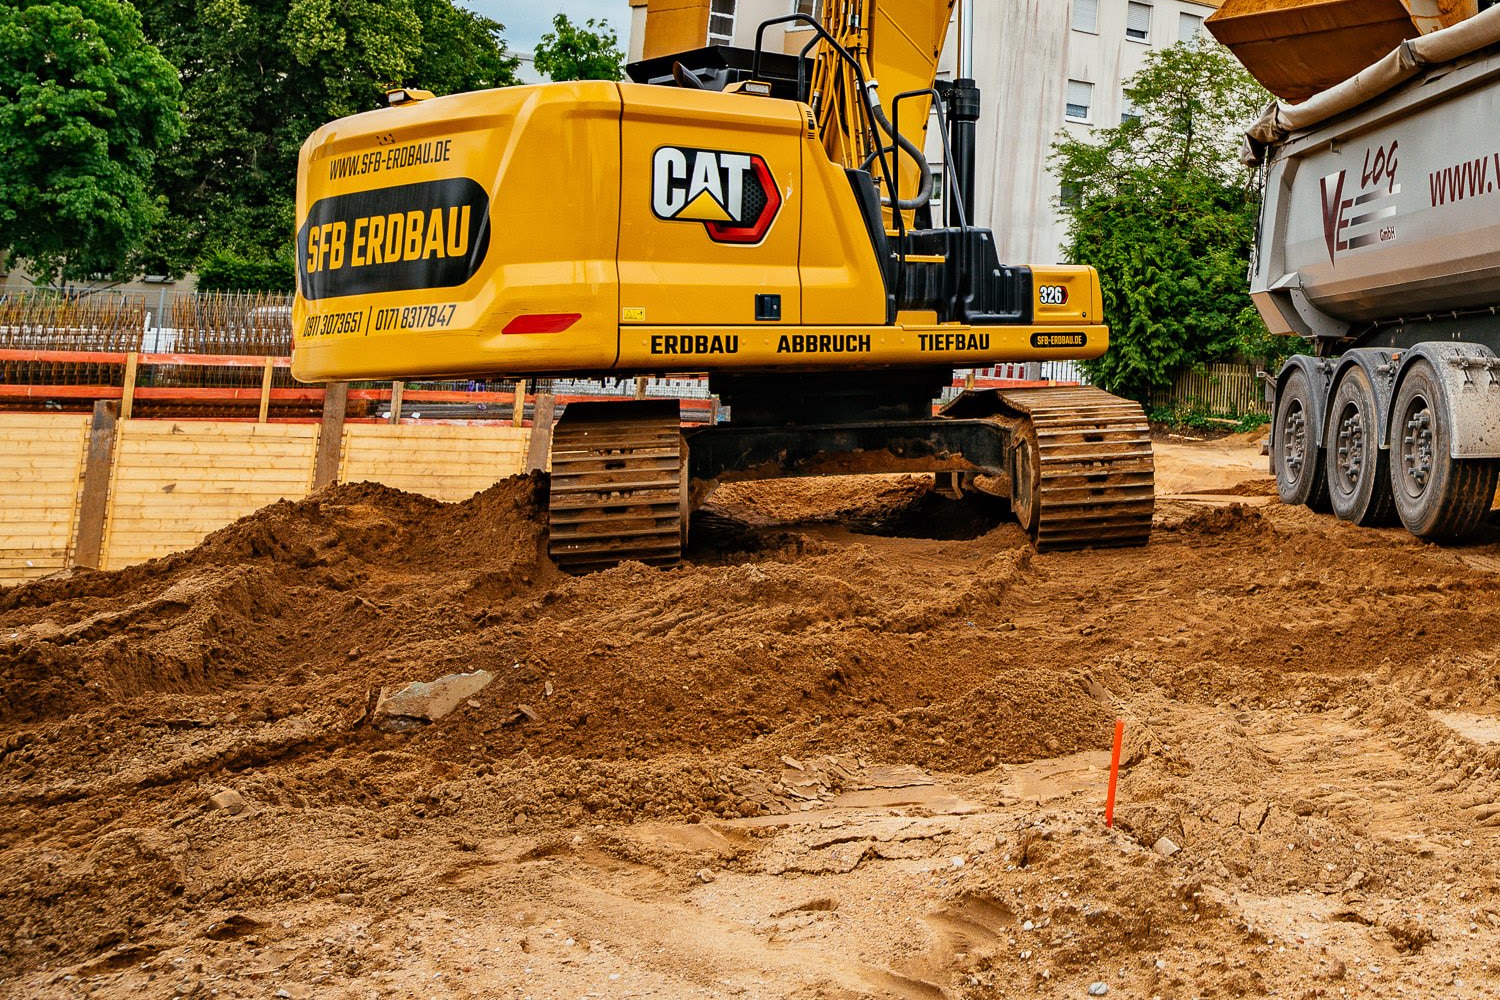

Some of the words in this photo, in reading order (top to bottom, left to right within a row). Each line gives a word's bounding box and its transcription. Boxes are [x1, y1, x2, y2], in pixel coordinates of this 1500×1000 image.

[330, 140, 452, 180] WWW.SFB-ERDBAU.DE
[1360, 140, 1399, 194] LOG
[654, 147, 751, 222] CAT
[1319, 169, 1354, 270] VE
[306, 220, 346, 274] SFB
[351, 204, 472, 267] ERDBAU
[1379, 226, 1396, 243] GmbH
[1040, 286, 1062, 304] 326
[303, 315, 320, 337] 0911
[320, 311, 363, 336] 3073651
[375, 308, 400, 330] 0171
[400, 304, 457, 329] 8317847
[651, 335, 739, 355] ERDBAU
[776, 334, 871, 354] ABBRUCH
[919, 334, 990, 351] TIEFBAU
[1037, 335, 1082, 345] SFB-ERDBAU.DE
